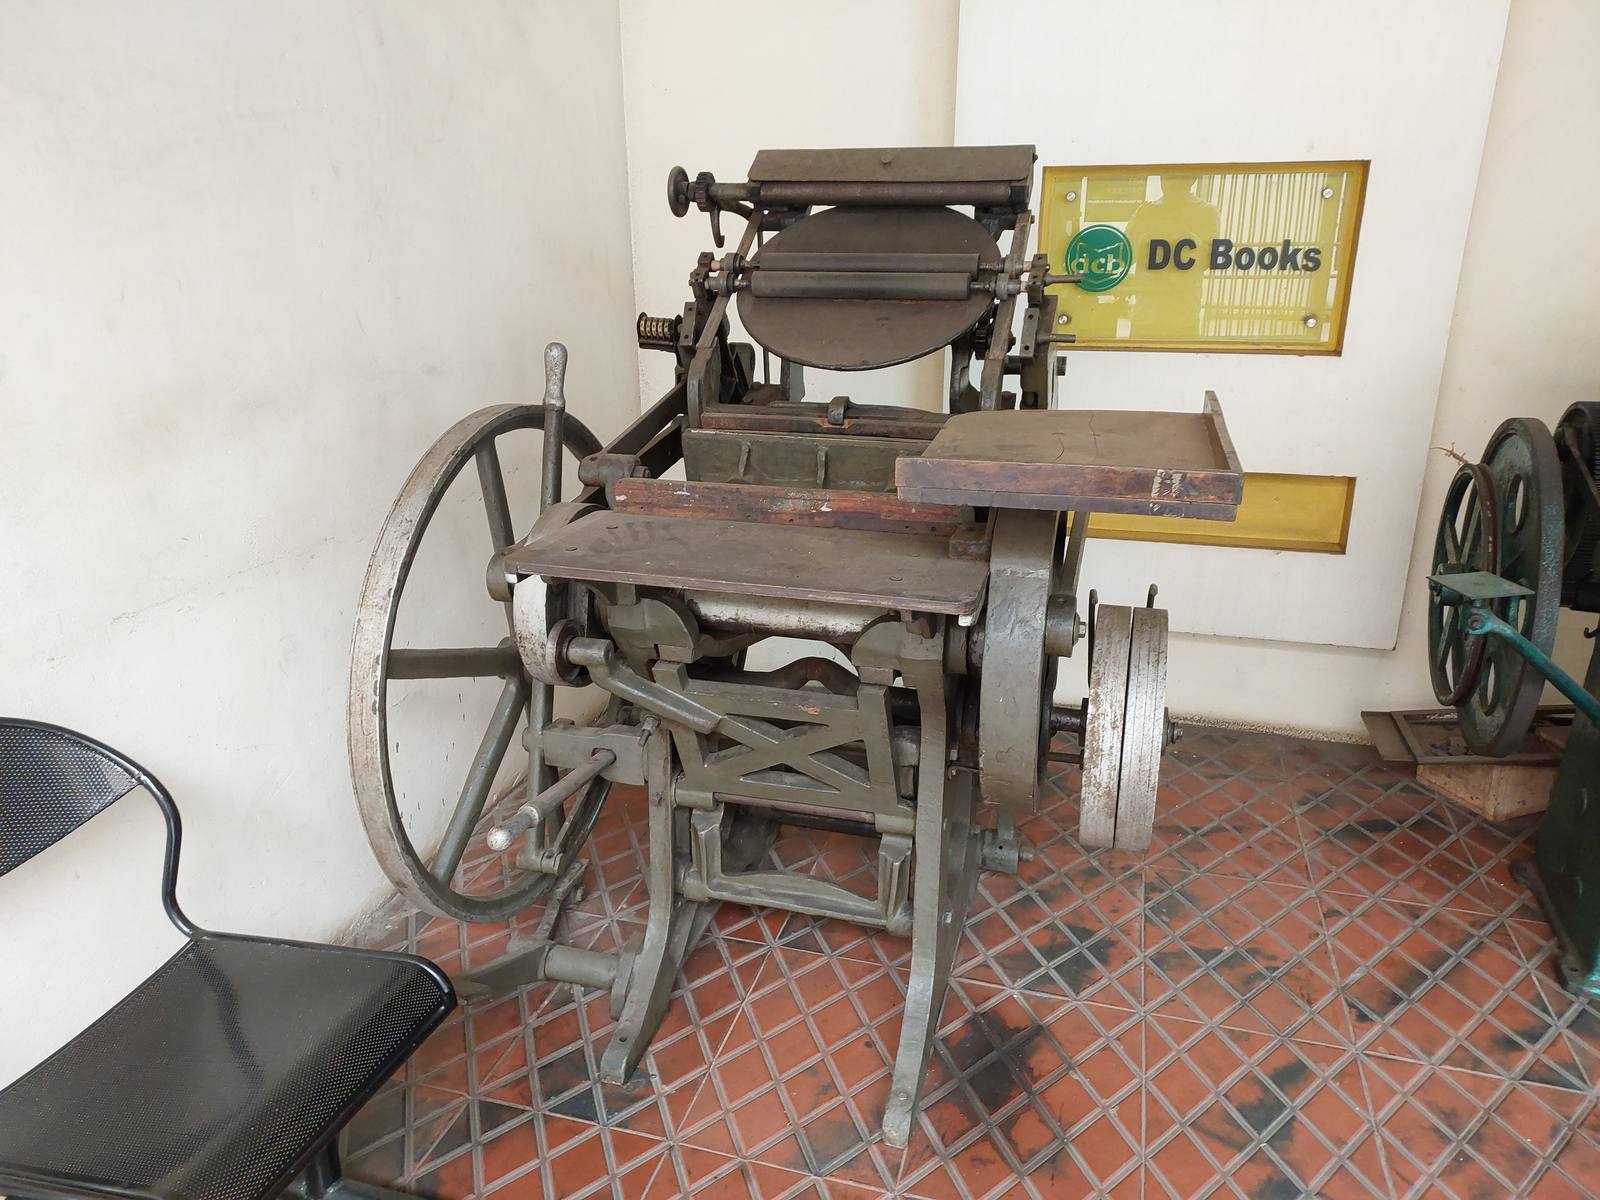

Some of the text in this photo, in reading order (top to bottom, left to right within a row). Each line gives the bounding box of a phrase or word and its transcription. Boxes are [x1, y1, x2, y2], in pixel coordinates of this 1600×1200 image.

[1070, 253, 1126, 275] dcb
[1148, 238, 1322, 272] DC Books
